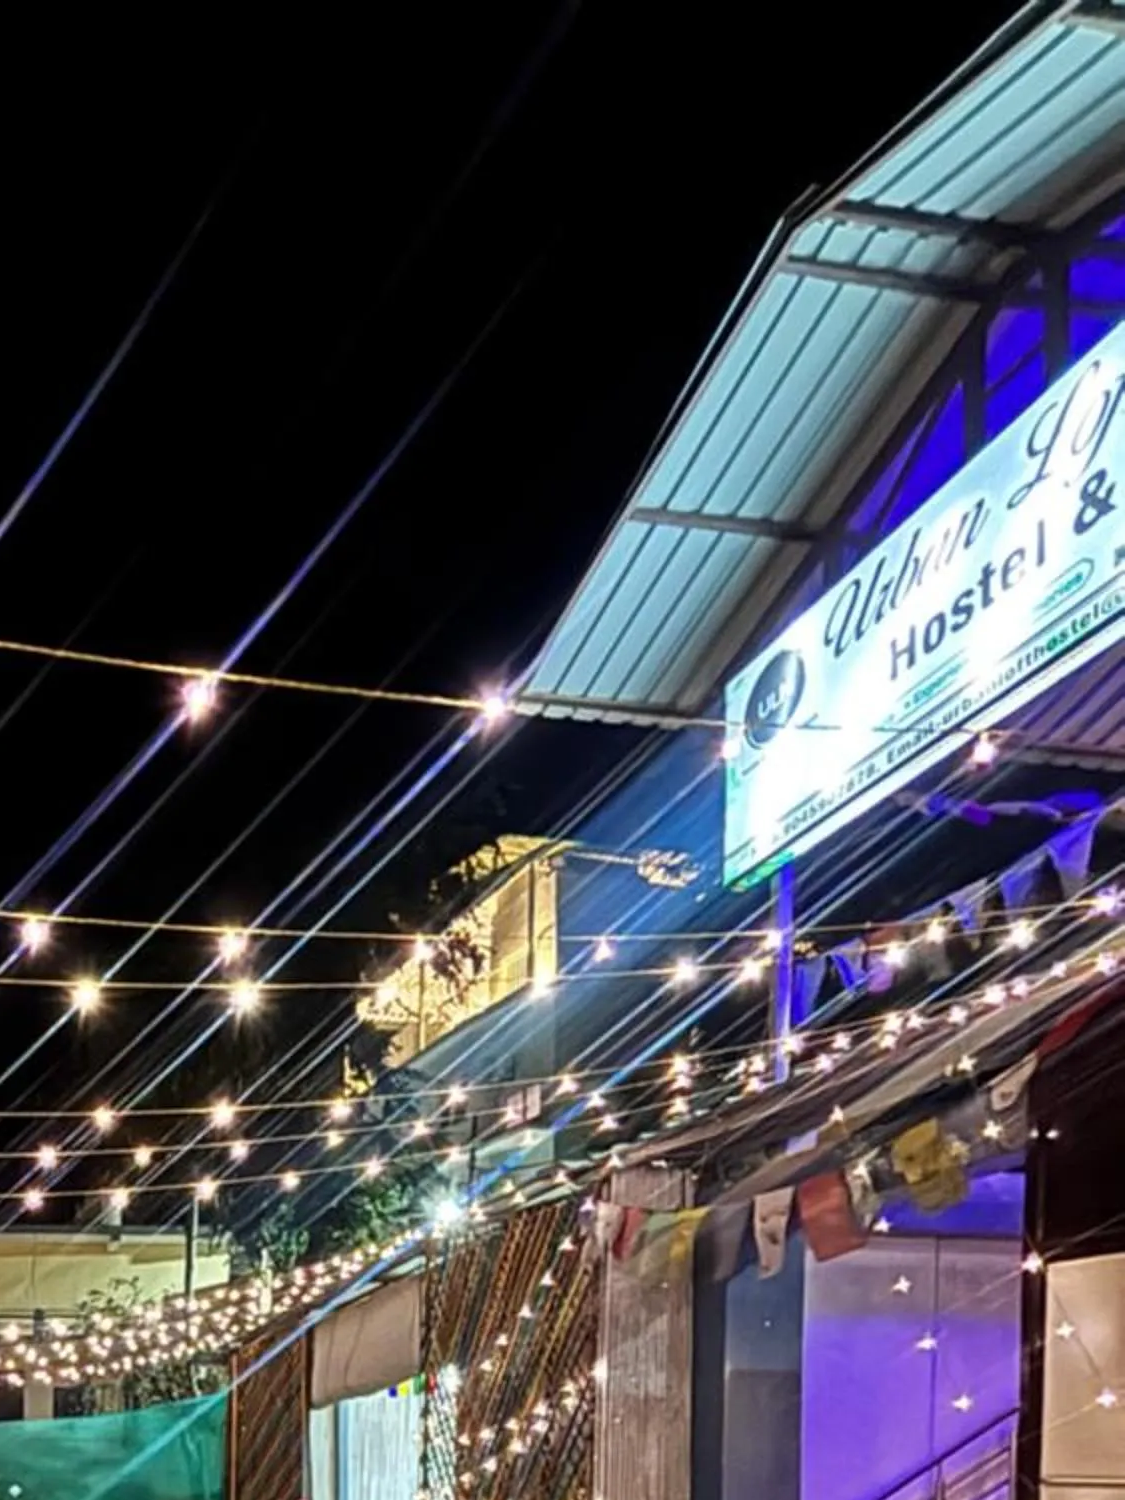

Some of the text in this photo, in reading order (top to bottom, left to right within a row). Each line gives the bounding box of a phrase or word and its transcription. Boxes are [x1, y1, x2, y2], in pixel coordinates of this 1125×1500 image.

[823, 497, 991, 658] Urban
[890, 518, 1046, 682] Hostel
[1073, 467, 1118, 536] &
